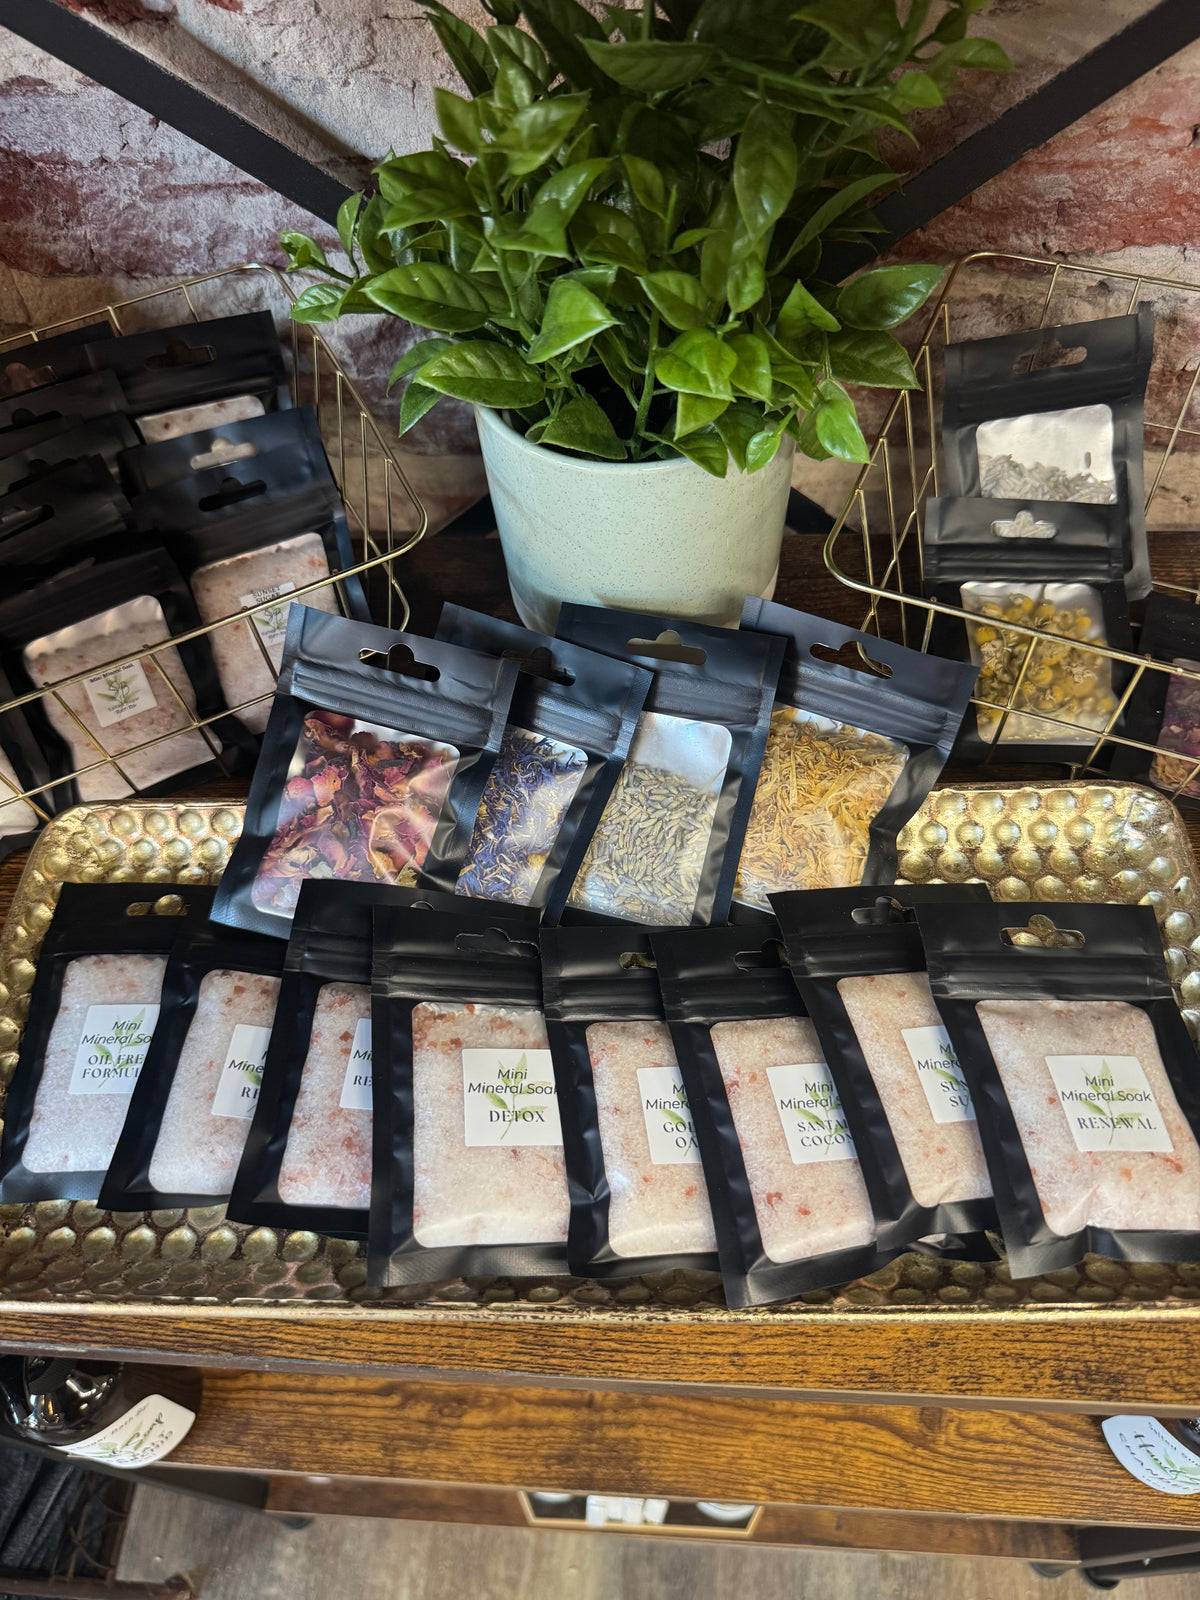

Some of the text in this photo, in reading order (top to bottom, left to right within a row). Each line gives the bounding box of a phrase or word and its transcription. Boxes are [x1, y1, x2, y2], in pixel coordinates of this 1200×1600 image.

[253, 585, 280, 599] SUNSET
[255, 592, 281, 603] SUGAR
[111, 1019, 144, 1031] Mini
[81, 1033, 153, 1045] Mineral So
[88, 1053, 144, 1065] OIL FRE
[228, 1059, 265, 1073] Mine
[497, 1068, 527, 1080] Mini
[1085, 1074, 1114, 1087] Mini
[468, 1082, 522, 1094] Mineral
[804, 1081, 834, 1093] Mini
[780, 1095, 833, 1110] Mineral
[1061, 1089, 1153, 1103] Mineral Soak
[489, 1110, 545, 1123] DETOX
[1077, 1117, 1157, 1131] RENEWAL
[800, 1133, 853, 1147] COCON
